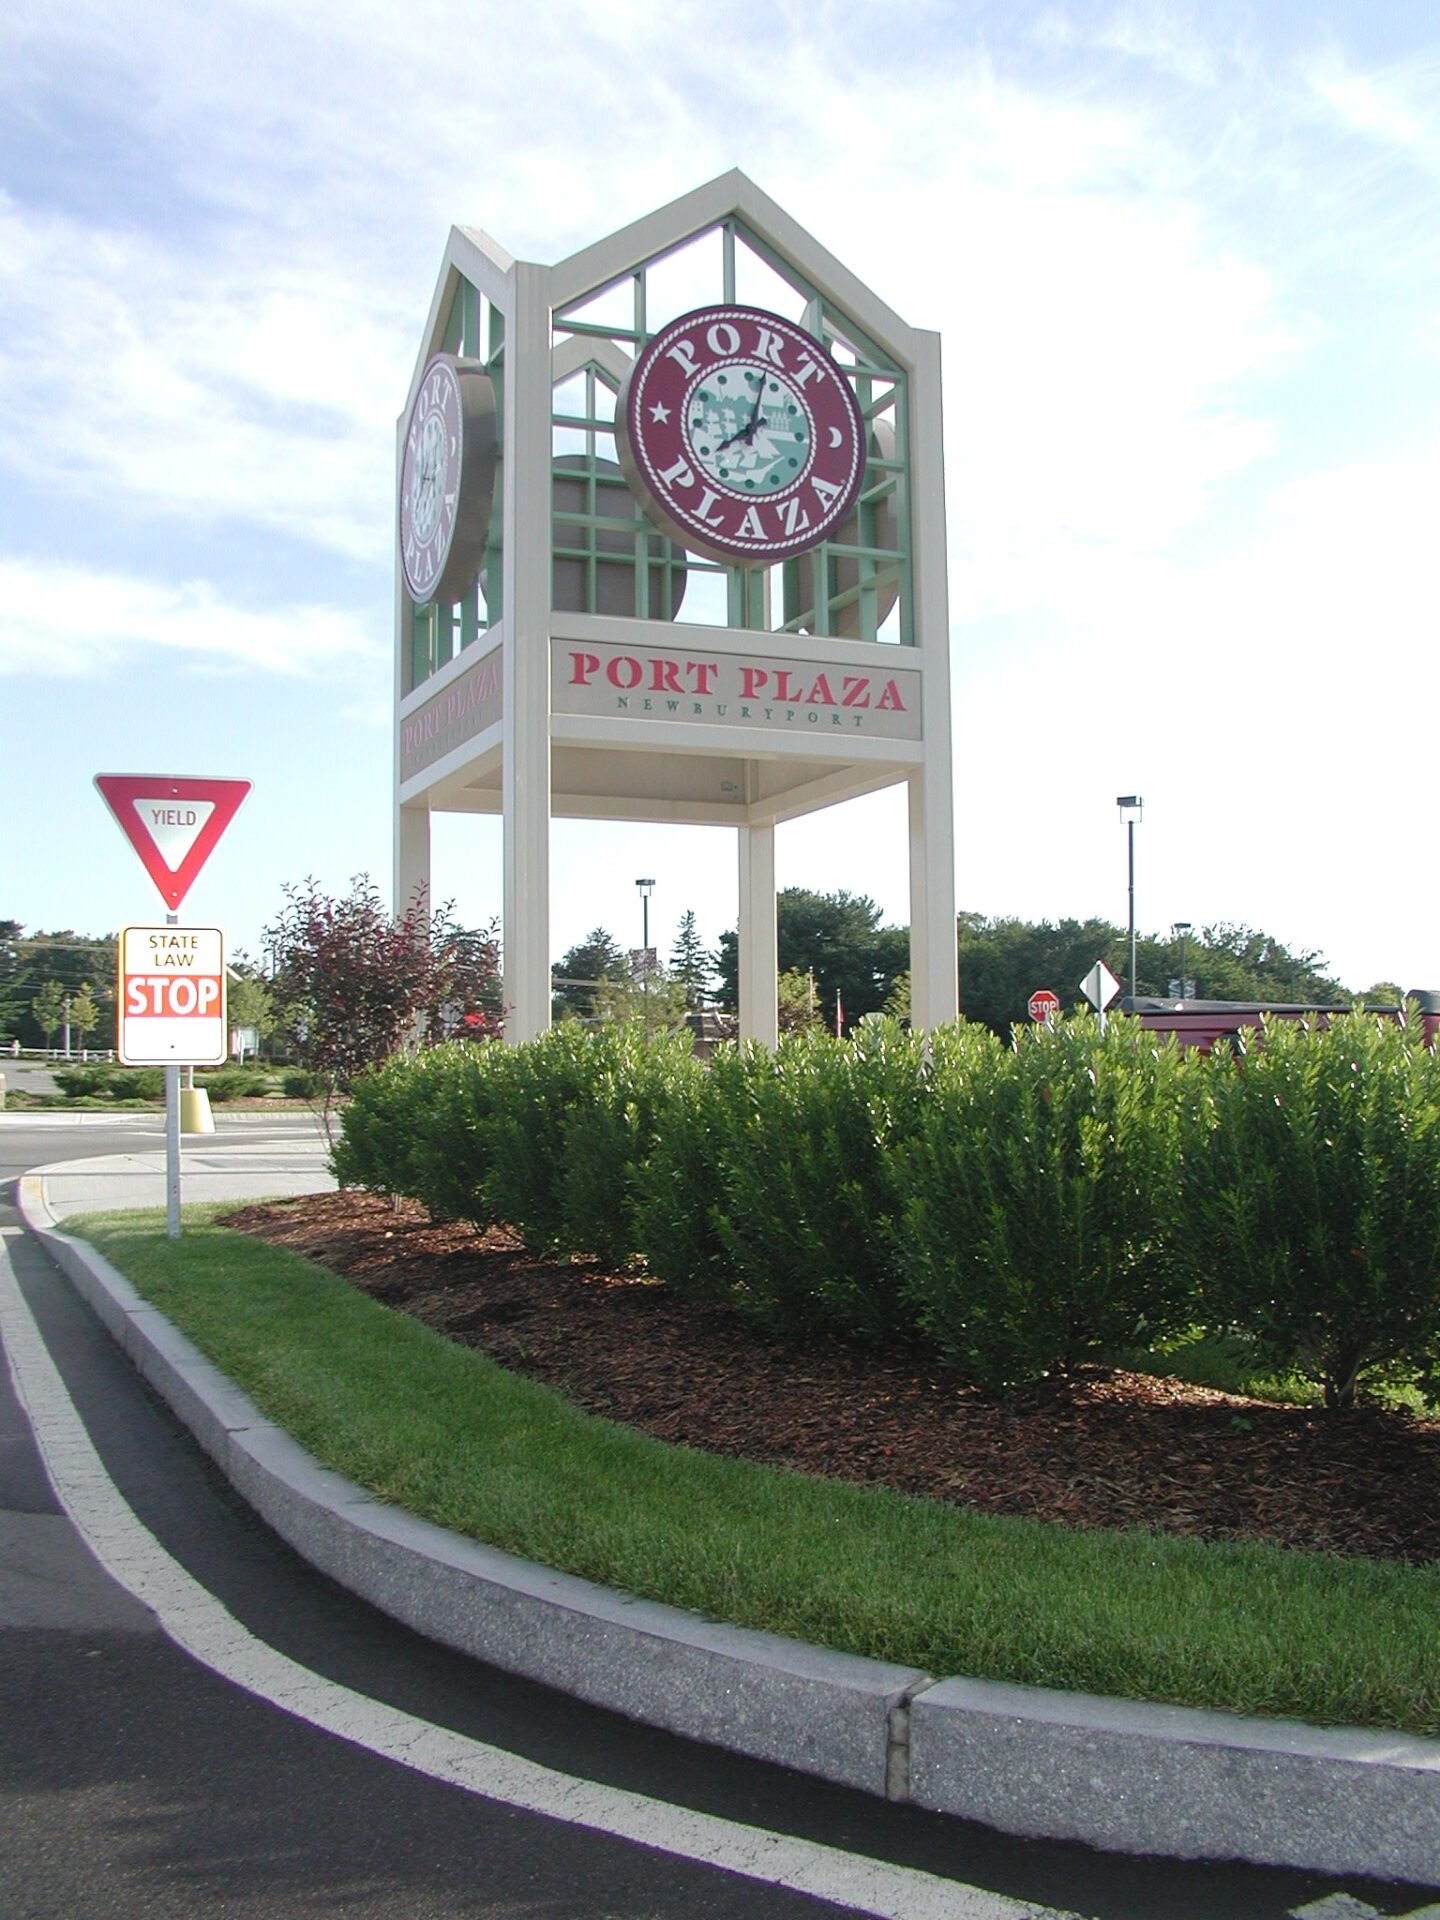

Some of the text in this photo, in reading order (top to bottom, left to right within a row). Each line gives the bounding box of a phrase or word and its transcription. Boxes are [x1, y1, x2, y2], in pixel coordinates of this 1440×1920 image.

[665, 322, 826, 390] PORT
[657, 454, 844, 541] PLAZA
[568, 651, 908, 712] PORT PLAZA
[404, 701, 441, 755] PORT
[444, 659, 499, 727] PLAZA
[616, 696, 864, 728] NEWBURYPORT
[151, 809, 197, 826] YIELD
[149, 935, 199, 949] STATE
[154, 953, 194, 967] LAW
[127, 977, 219, 1015] STOP
[1031, 1000, 1057, 1014] STOP
